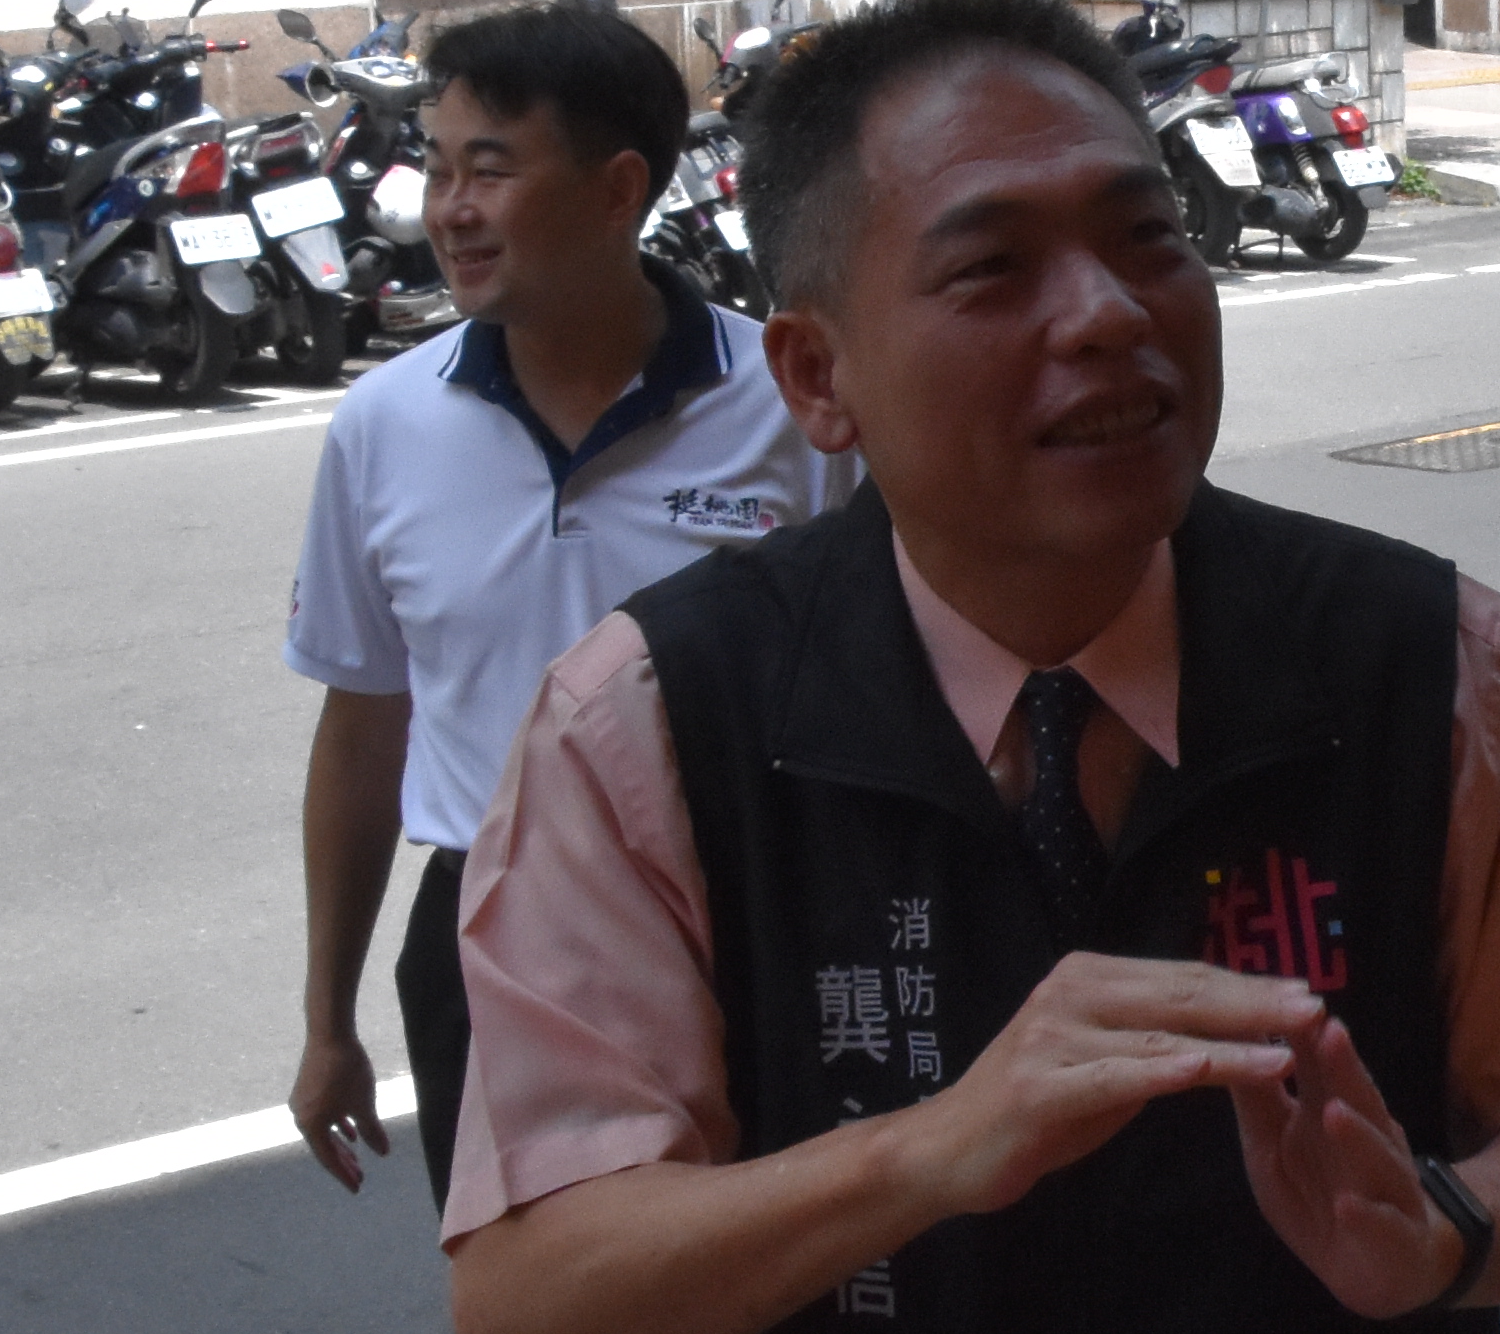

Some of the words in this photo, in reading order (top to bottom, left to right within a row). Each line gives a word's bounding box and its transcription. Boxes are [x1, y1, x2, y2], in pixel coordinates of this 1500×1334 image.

[662, 488, 759, 523] 挺桃園
[888, 897, 943, 1103] 消防局
[815, 964, 896, 1319] 龔信
